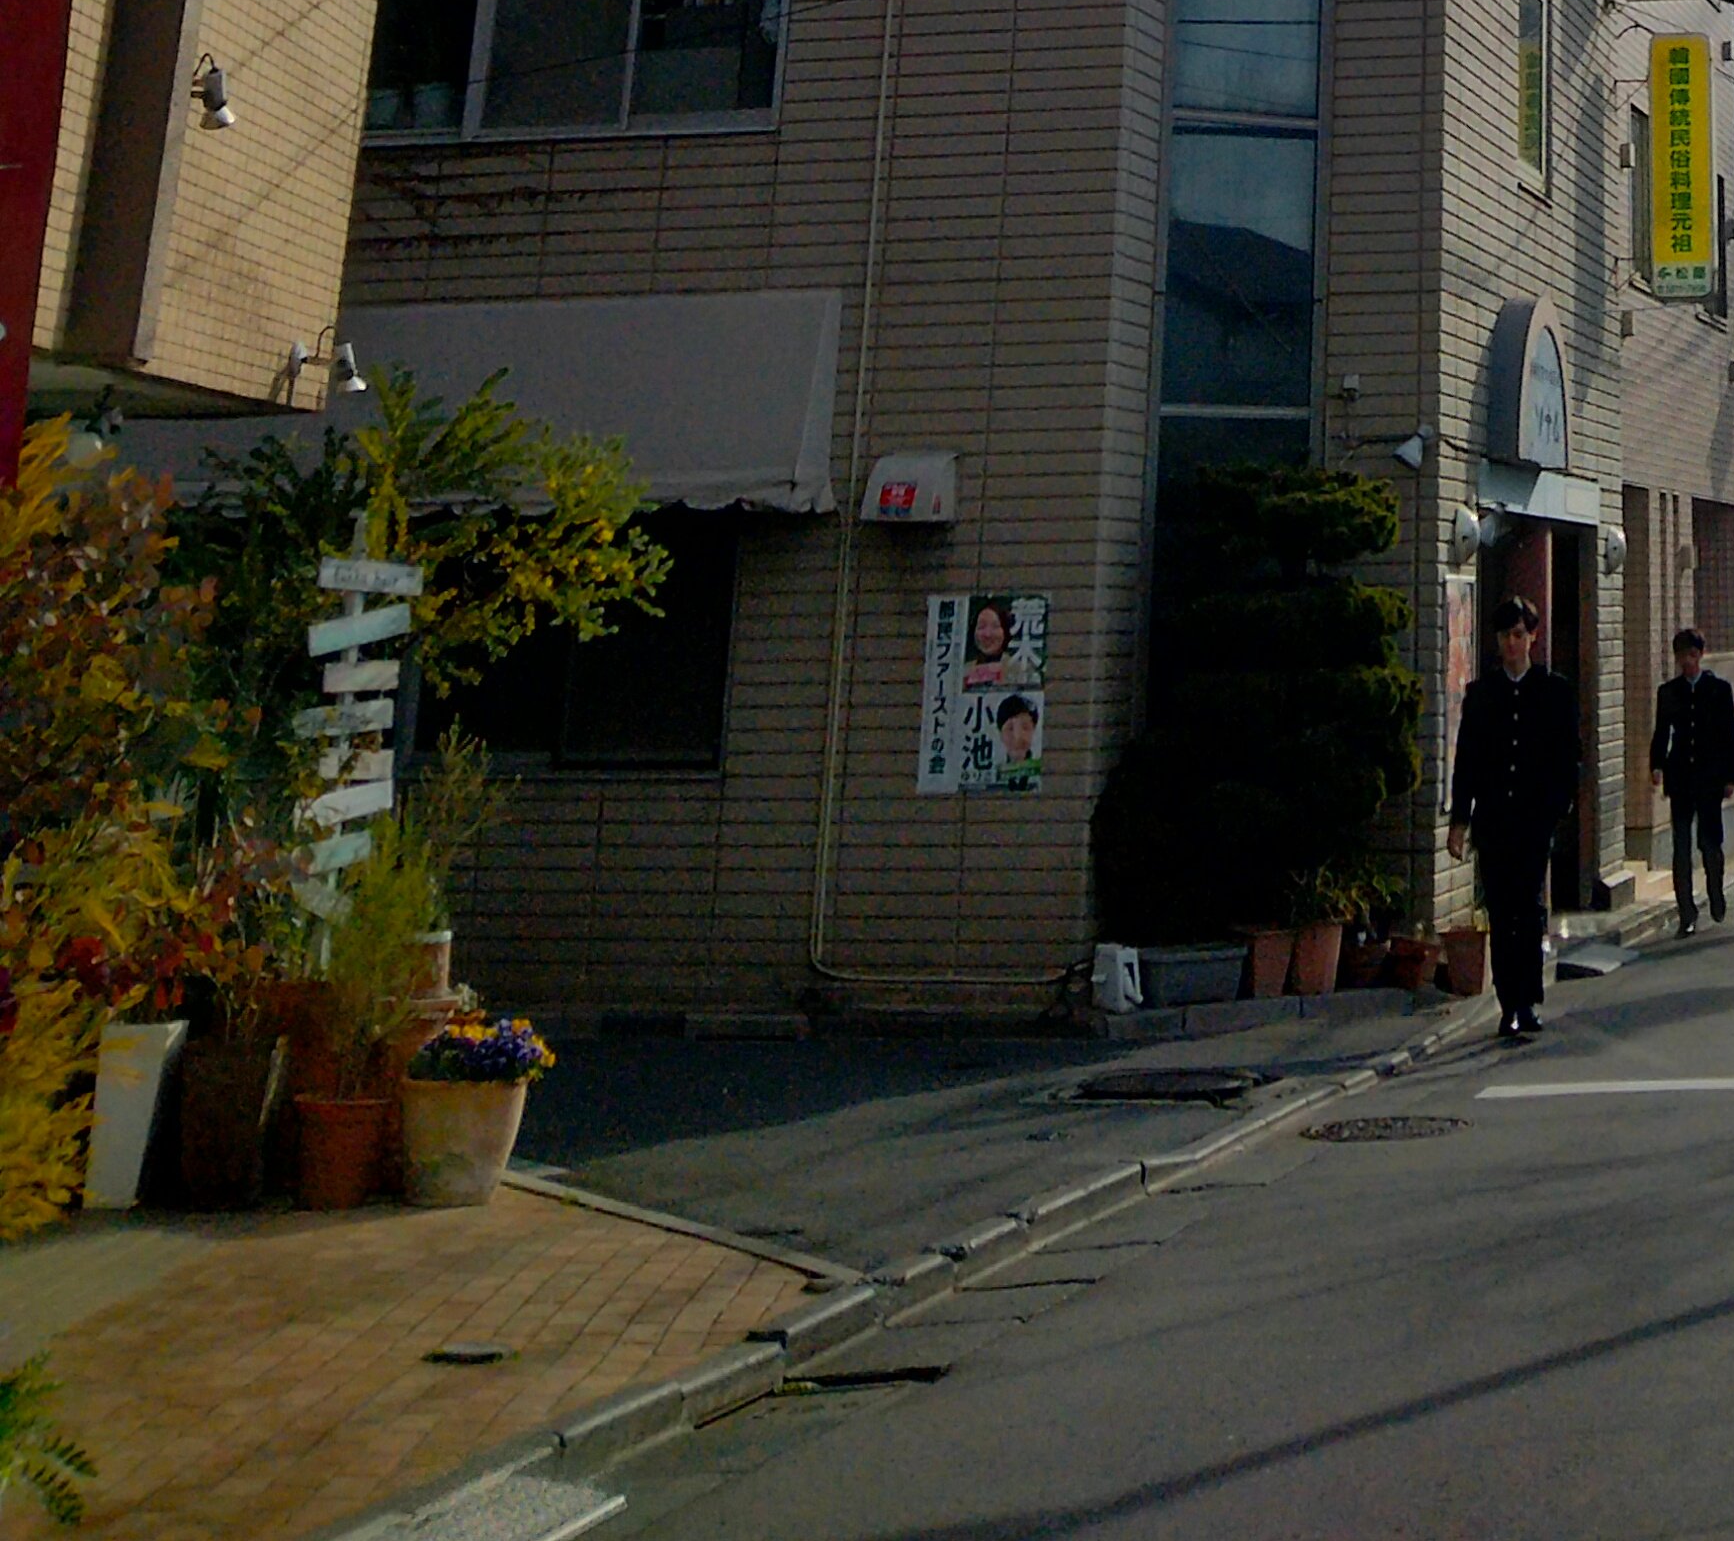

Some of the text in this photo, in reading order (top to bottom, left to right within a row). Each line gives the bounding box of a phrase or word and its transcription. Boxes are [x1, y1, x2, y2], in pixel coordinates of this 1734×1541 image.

[1007, 597, 1047, 669] 荒木
[928, 599, 955, 775] 都民ファーストの会
[962, 696, 995, 771] 小池
